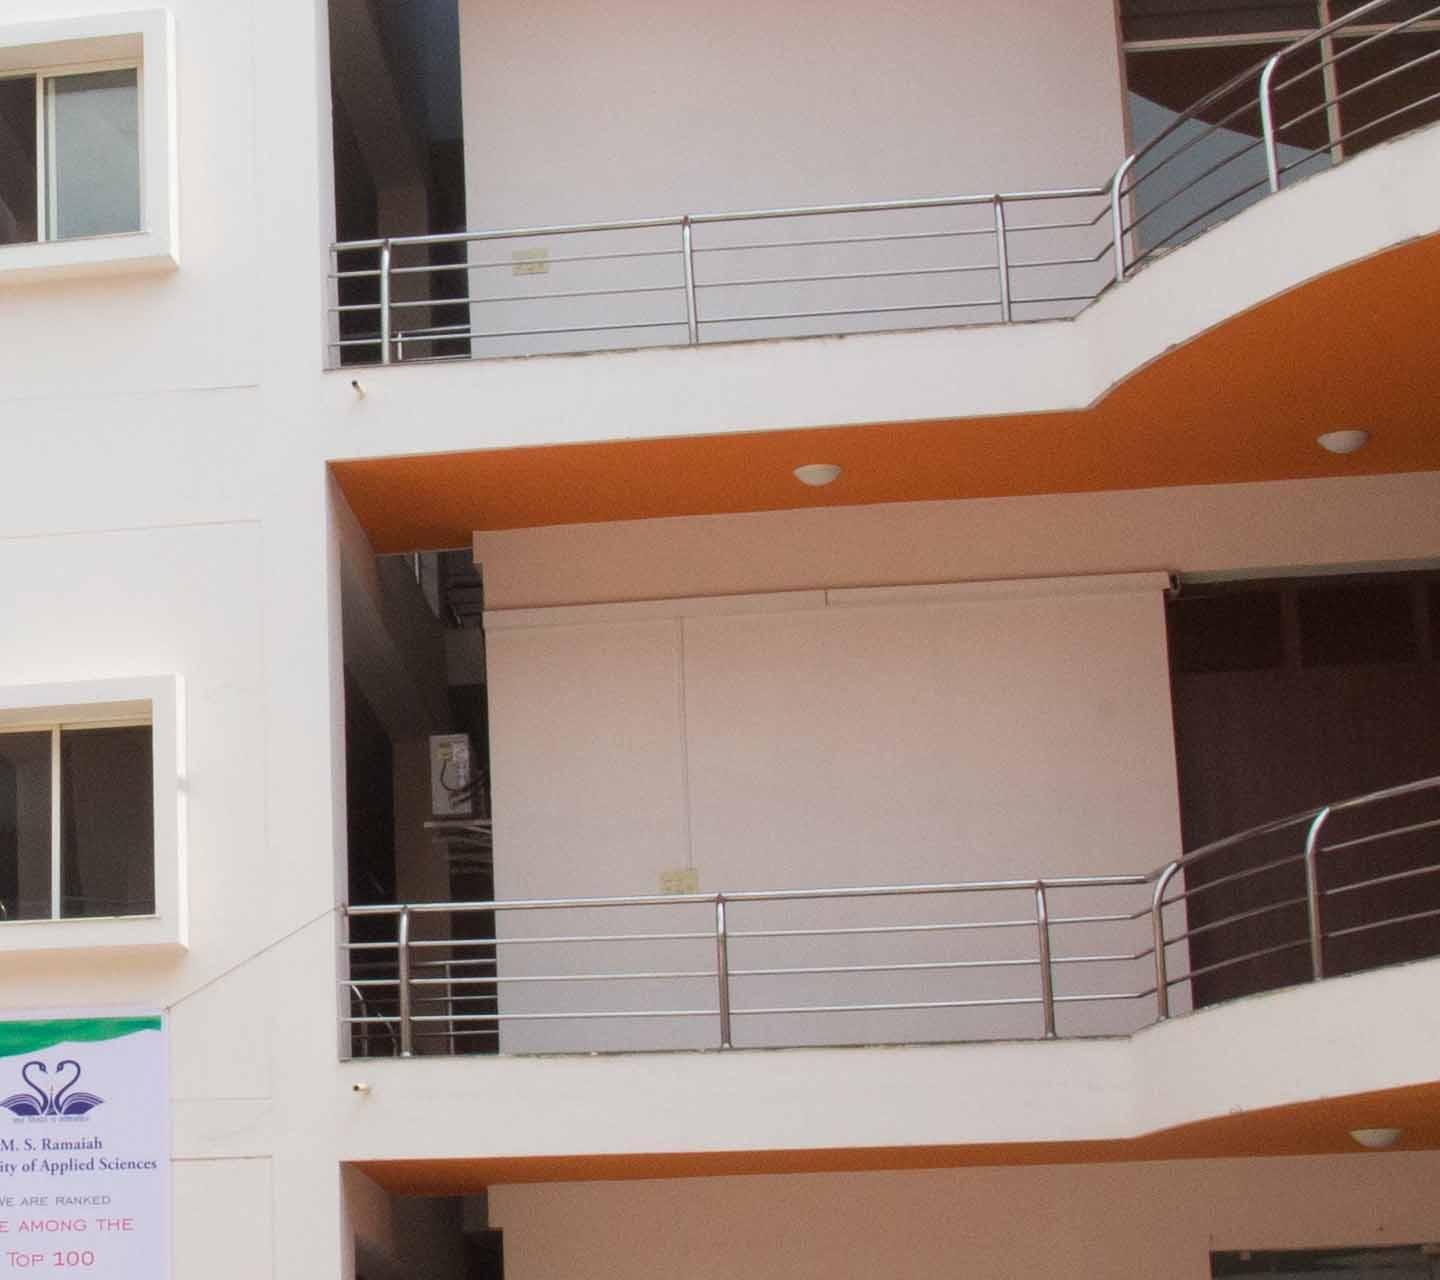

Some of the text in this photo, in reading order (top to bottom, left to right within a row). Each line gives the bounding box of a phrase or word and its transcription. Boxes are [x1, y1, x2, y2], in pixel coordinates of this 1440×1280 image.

[0, 1137, 103, 1152] M. S. Ramaiah
[22, 1159, 37, 1173] of
[40, 1158, 95, 1175] Applied
[99, 1158, 157, 1171] Sciences
[20, 1196, 48, 1207] ARE
[55, 1195, 111, 1207] RANKED
[18, 1219, 87, 1233] AMONG
[95, 1218, 134, 1231] THE
[53, 1250, 95, 1266] 100
